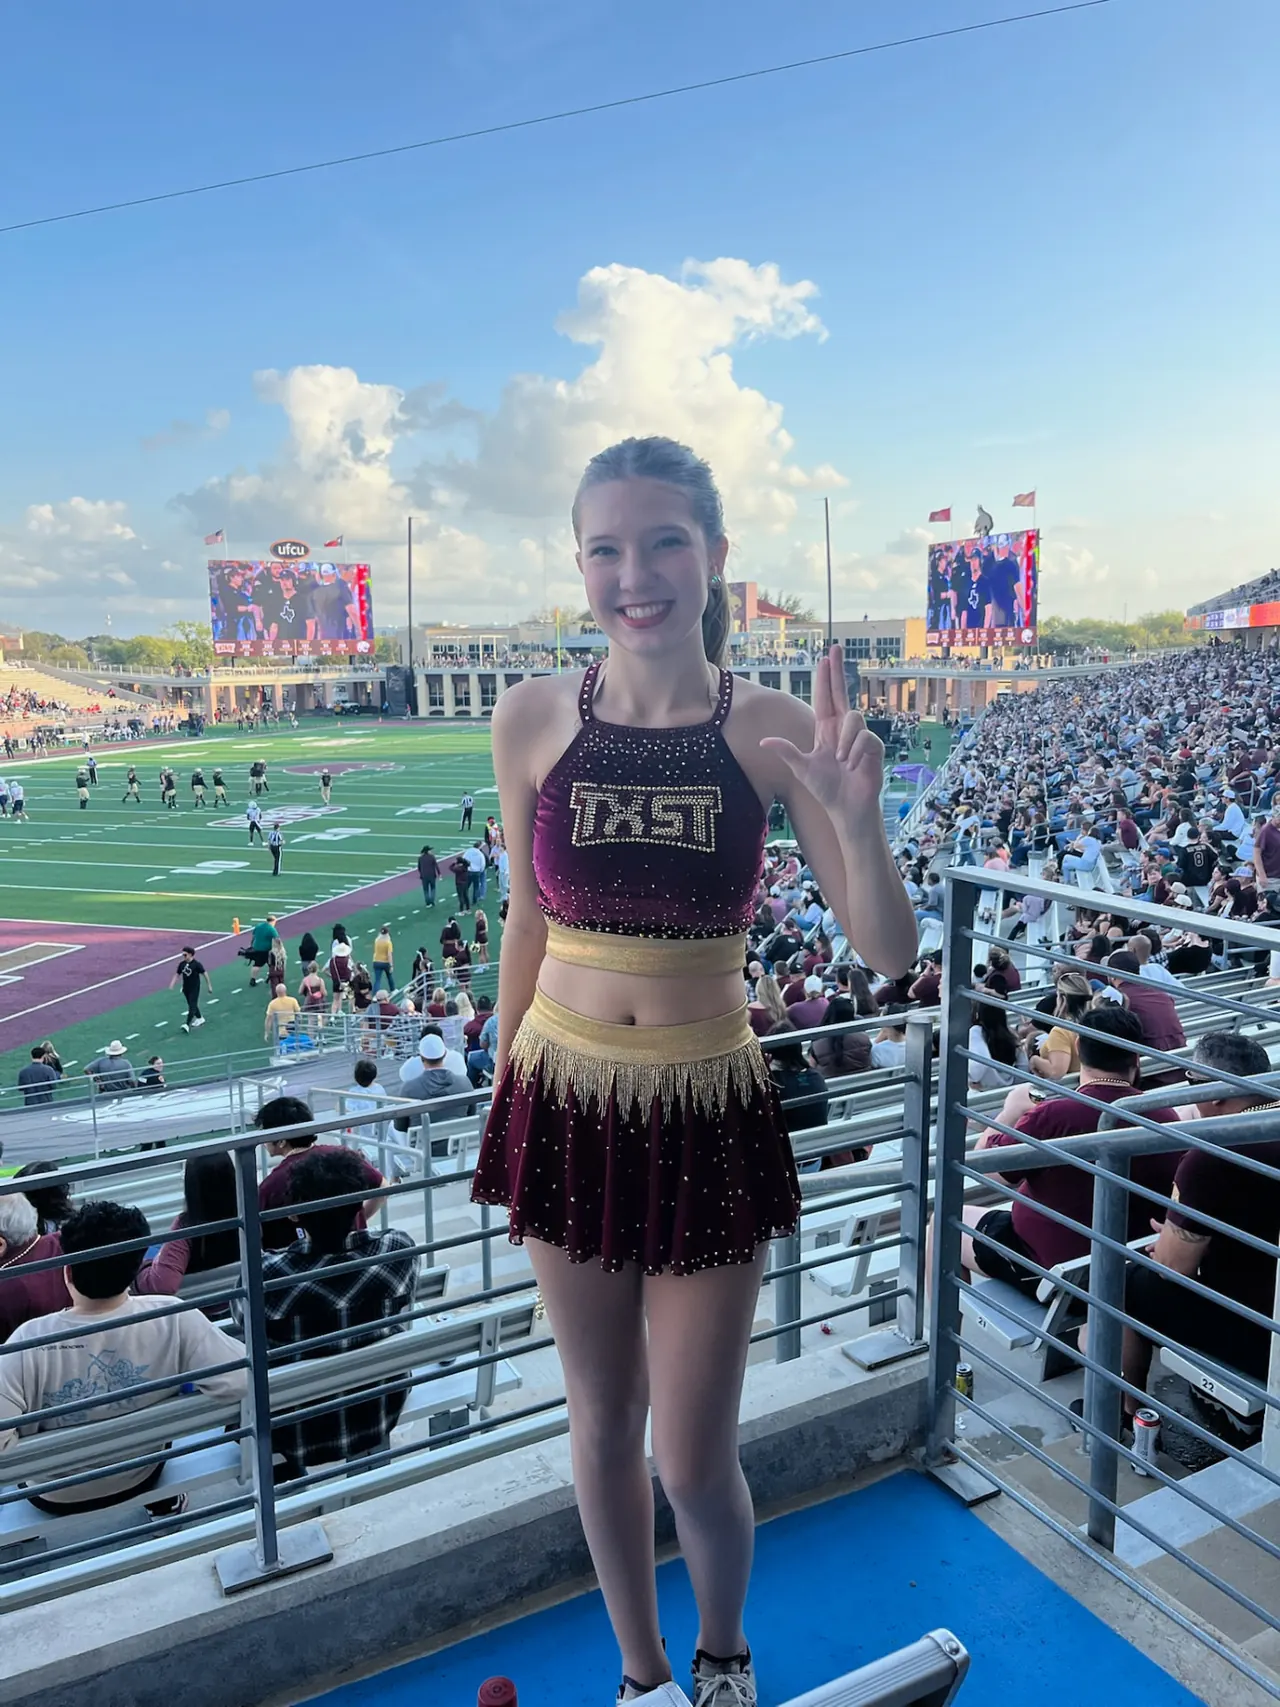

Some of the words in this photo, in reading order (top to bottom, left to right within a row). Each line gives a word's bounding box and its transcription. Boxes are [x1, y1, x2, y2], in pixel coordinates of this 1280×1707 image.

[277, 544, 305, 556] ufcu
[571, 784, 721, 850] TXST
[1193, 851, 1204, 867] 8
[978, 1316, 987, 1329] 21
[1202, 1378, 1215, 1393] 22
